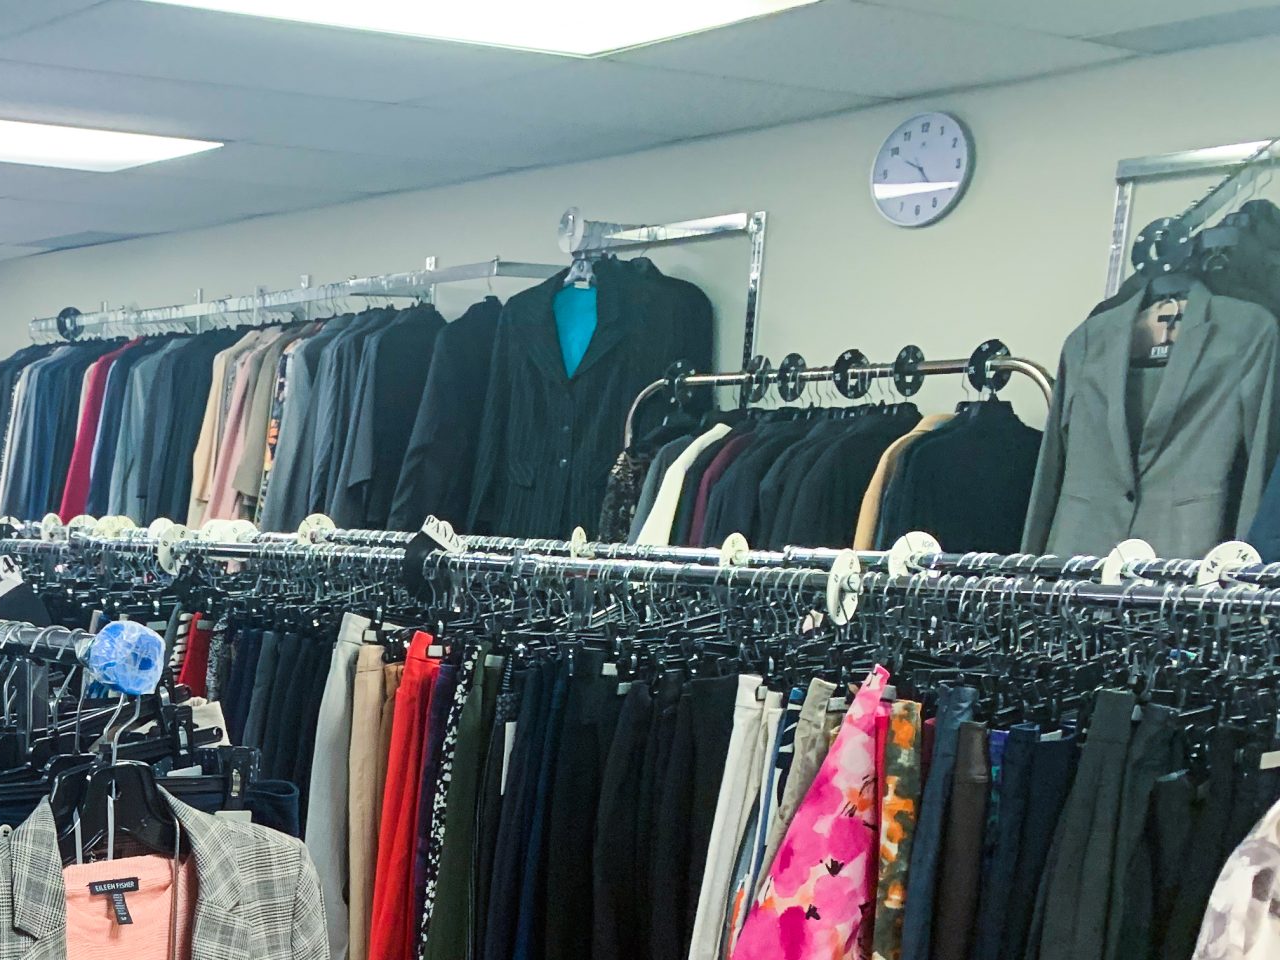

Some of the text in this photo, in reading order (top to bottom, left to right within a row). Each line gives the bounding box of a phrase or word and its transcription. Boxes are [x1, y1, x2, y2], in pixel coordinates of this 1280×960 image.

[1205, 559, 1218, 574] 14
[95, 880, 135, 892] EILEEN FISHER
